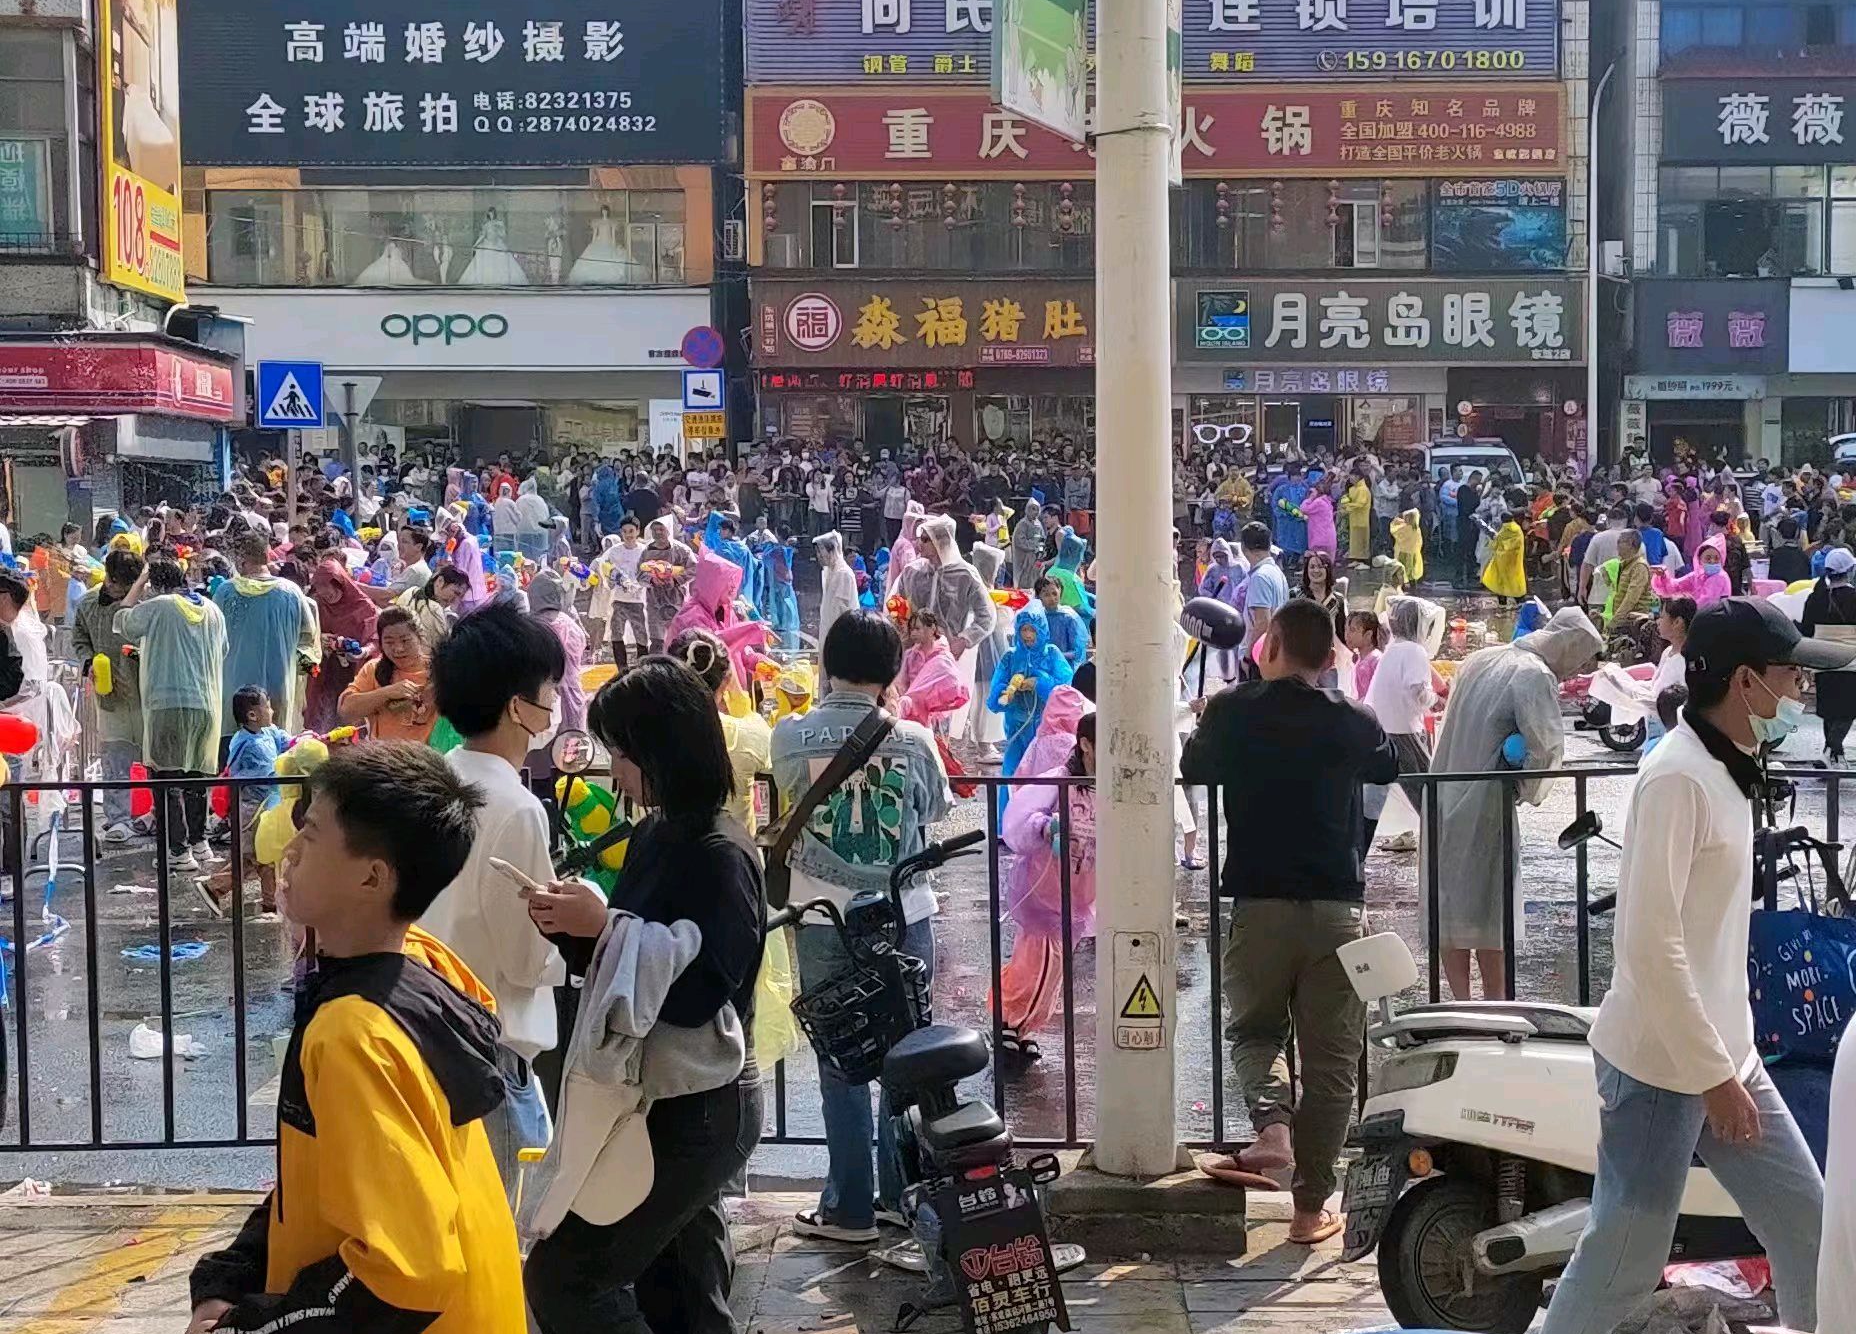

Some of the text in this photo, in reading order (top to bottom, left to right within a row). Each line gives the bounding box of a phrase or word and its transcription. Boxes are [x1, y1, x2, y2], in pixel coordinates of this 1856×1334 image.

[284, 21, 625, 64] 高端婚纱摄影
[245, 91, 459, 134] 全球旅拍
[1339, 98, 1537, 118] 重庆知名品牌
[1717, 91, 1845, 146] 薇薇
[1339, 144, 1483, 161] 打造全国平价老火锅
[1264, 289, 1564, 350] 月亮岛眼镜
[1254, 370, 1390, 393] 月亮岛眼镜
